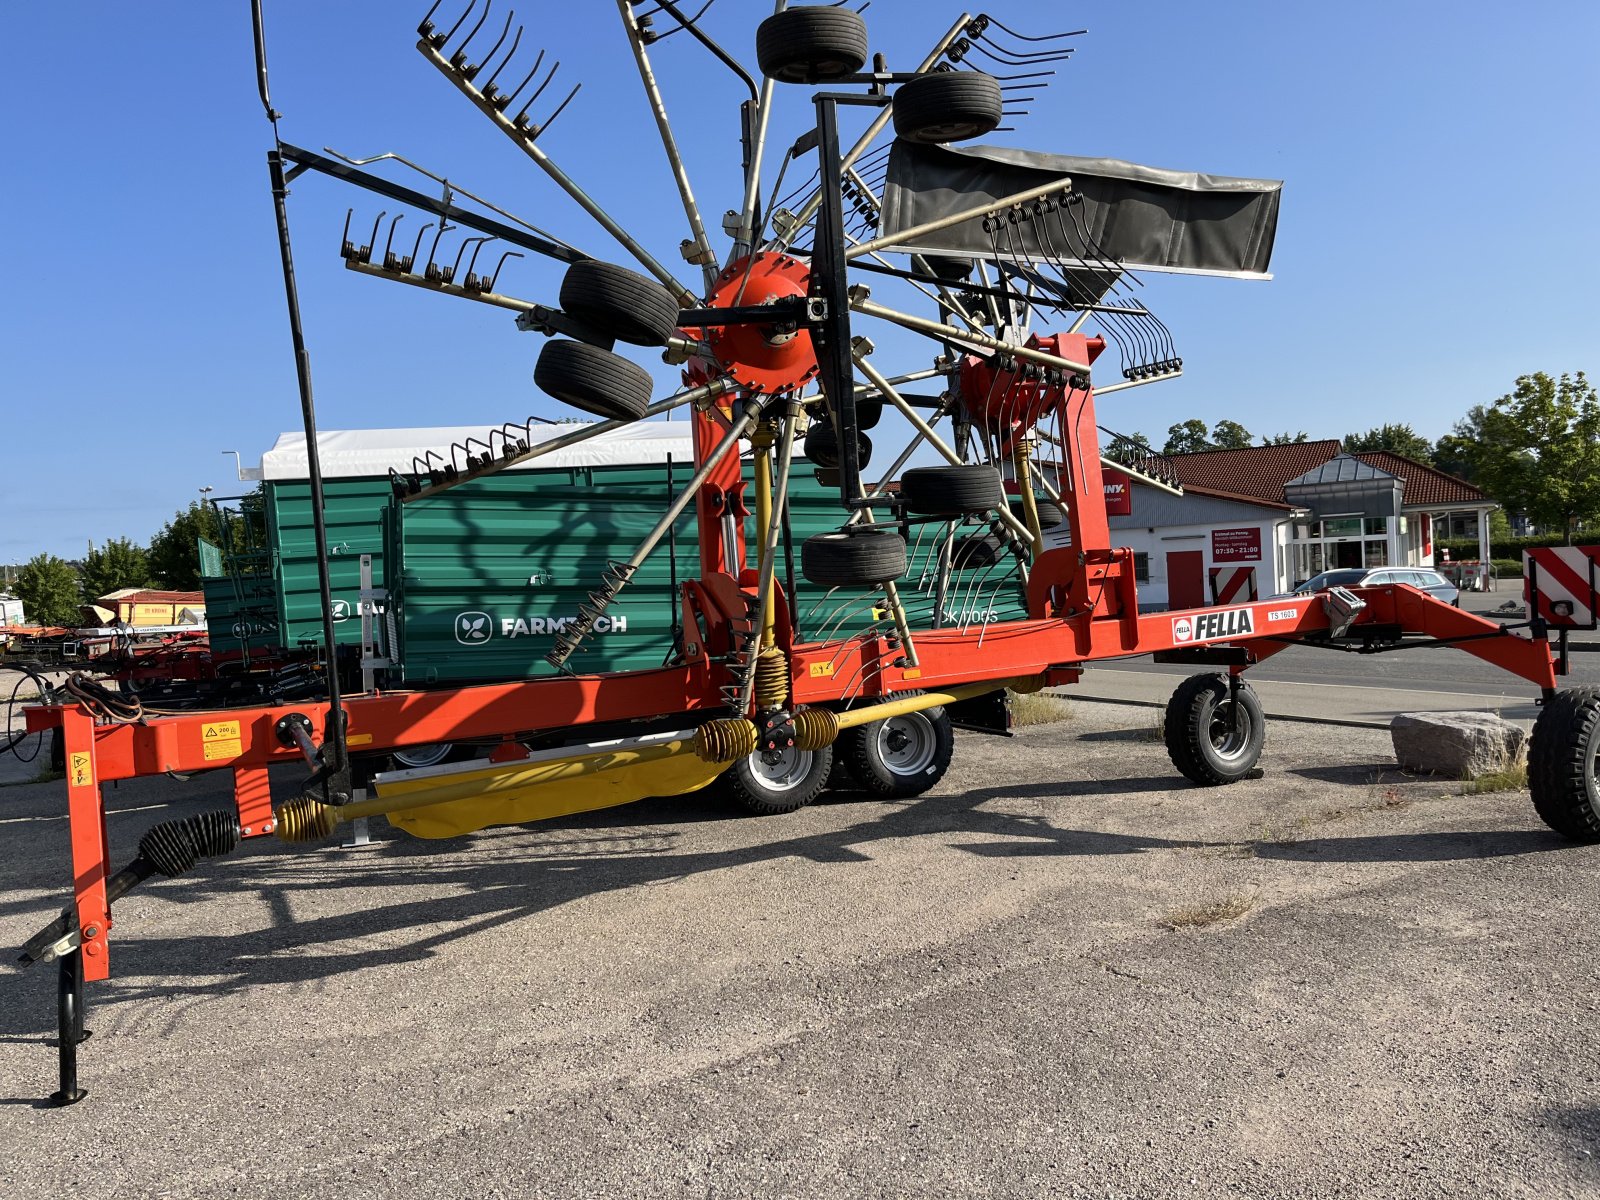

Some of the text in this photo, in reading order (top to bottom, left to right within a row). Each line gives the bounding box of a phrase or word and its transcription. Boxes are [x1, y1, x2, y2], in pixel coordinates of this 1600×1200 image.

[1195, 610, 1252, 640] FELLA
[1270, 610, 1294, 620] TS 1603
